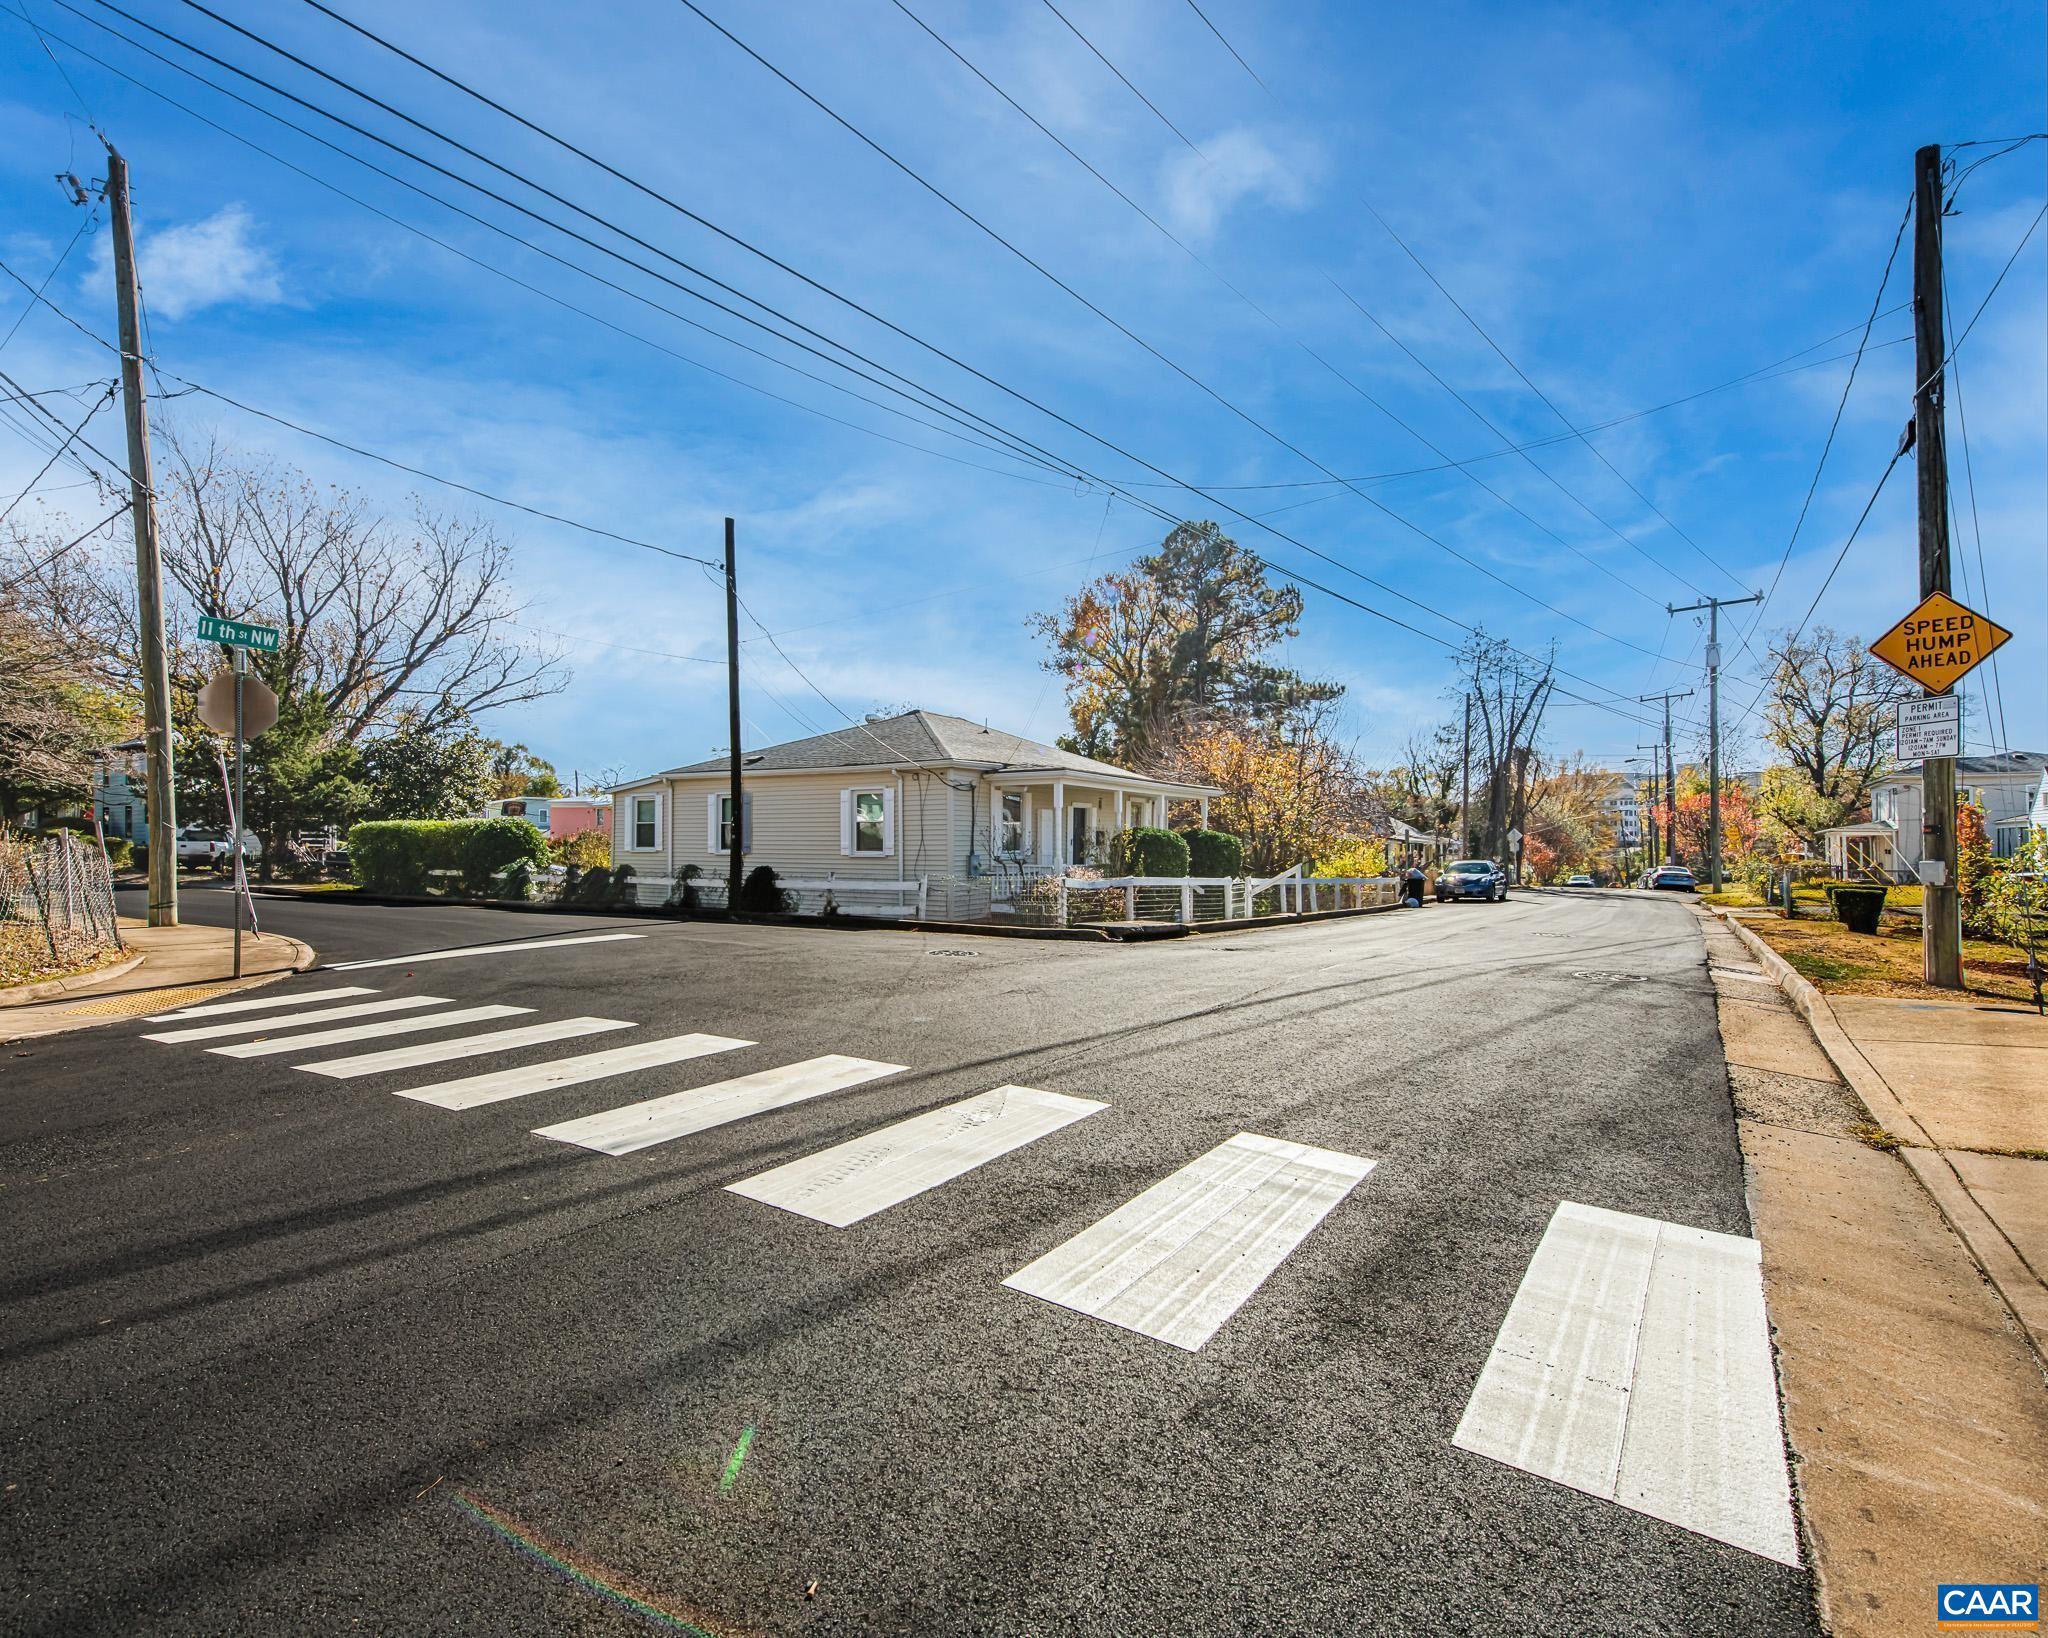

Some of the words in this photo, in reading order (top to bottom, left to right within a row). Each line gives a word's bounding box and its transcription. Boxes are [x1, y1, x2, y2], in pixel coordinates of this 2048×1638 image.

[1903, 615, 1974, 636] SPEED
[219, 624, 236, 640] th
[238, 630, 248, 640] St
[251, 629, 276, 647] NW
[1906, 633, 1971, 652] HUMP
[1908, 651, 1971, 669] AHEAD
[1910, 701, 1943, 713] PERMIT
[1905, 714, 1931, 722] PARKING
[1934, 711, 1949, 719] AREA
[1924, 728, 1953, 736] REQUIRED
